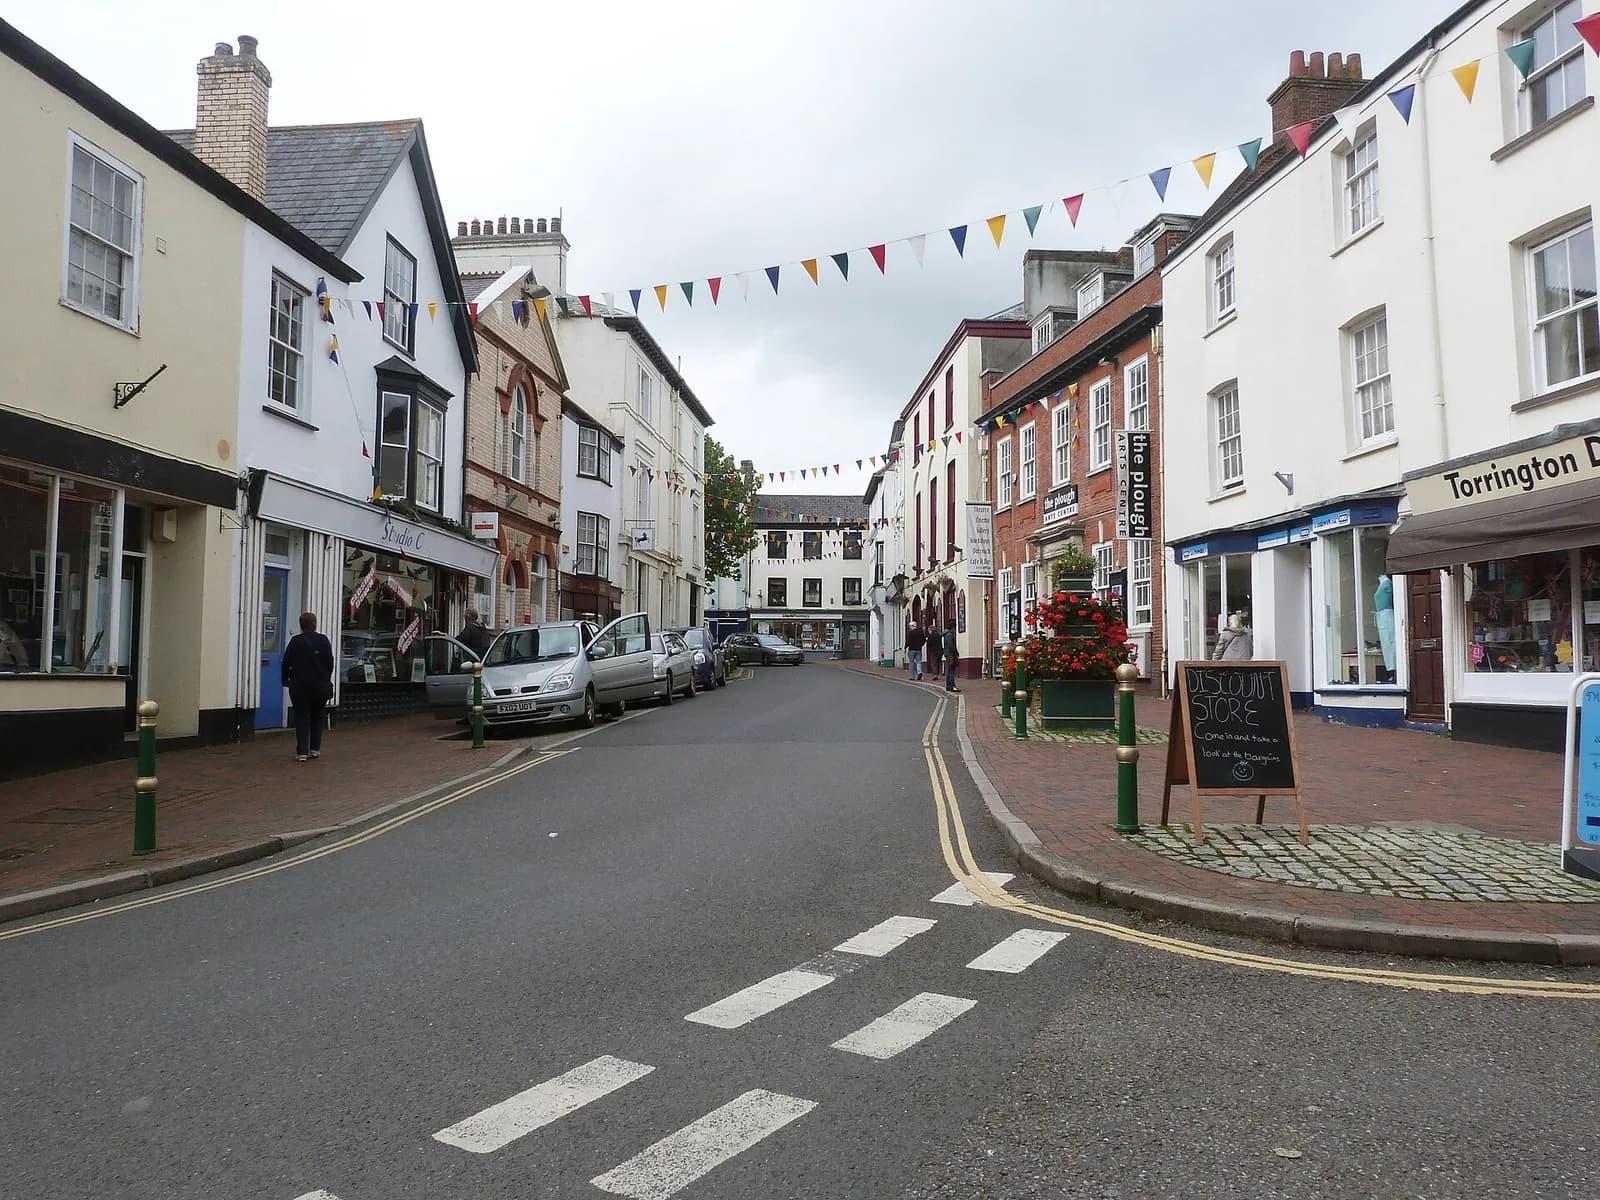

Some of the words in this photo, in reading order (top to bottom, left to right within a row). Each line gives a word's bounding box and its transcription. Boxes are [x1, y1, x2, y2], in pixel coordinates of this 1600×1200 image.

[1118, 434, 1127, 470] ARTS
[1133, 434, 1148, 465] the
[1444, 453, 1578, 499] Torrington
[1044, 497, 1054, 510] the
[1054, 488, 1075, 510] plough
[1045, 511, 1056, 521] ARTS
[1057, 505, 1075, 518] CENTRE
[1119, 480, 1127, 537] CENTRE
[1130, 471, 1150, 537] plough
[416, 531, 425, 550] C
[1187, 668, 1275, 700] DISCOUNT
[1192, 694, 1260, 726] STORE
[1194, 721, 1225, 741] Come
[1224, 732, 1233, 740] in
[1234, 734, 1250, 742] and
[1252, 734, 1271, 744] take
[1201, 747, 1221, 758] look
[1232, 751, 1243, 759] the
